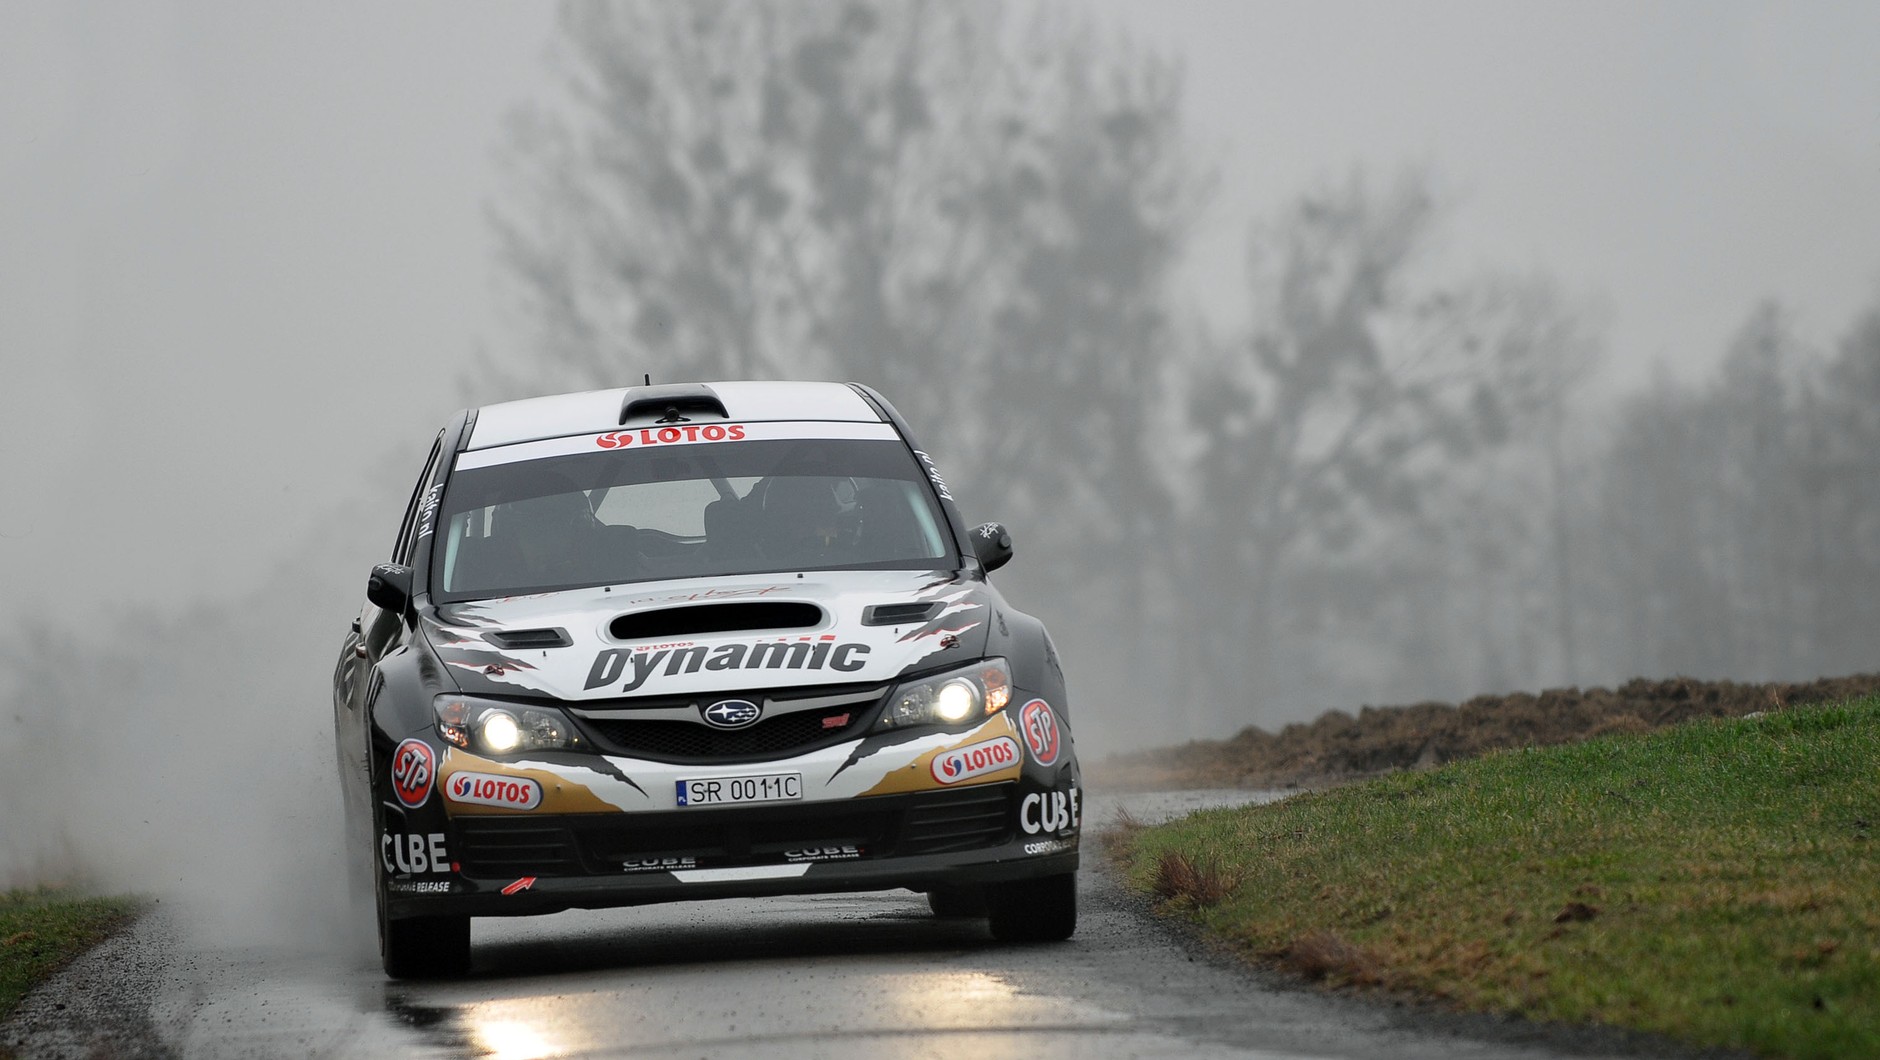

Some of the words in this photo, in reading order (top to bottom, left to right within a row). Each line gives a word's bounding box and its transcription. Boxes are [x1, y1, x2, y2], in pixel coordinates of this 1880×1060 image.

[640, 425, 745, 445] LOTOS
[653, 641, 694, 650] LOTOS
[583, 635, 871, 693] Dynamic
[1030, 707, 1052, 754] STP
[395, 749, 428, 791] STP
[963, 742, 1013, 772] LOTOS
[474, 779, 531, 804] LOTOS
[691, 782, 722, 803] SR
[731, 776, 798, 800] 0011C
[1021, 788, 1078, 834] CUBE
[1024, 840, 1063, 854] CORPO
[416, 881, 450, 893] RELEASE
